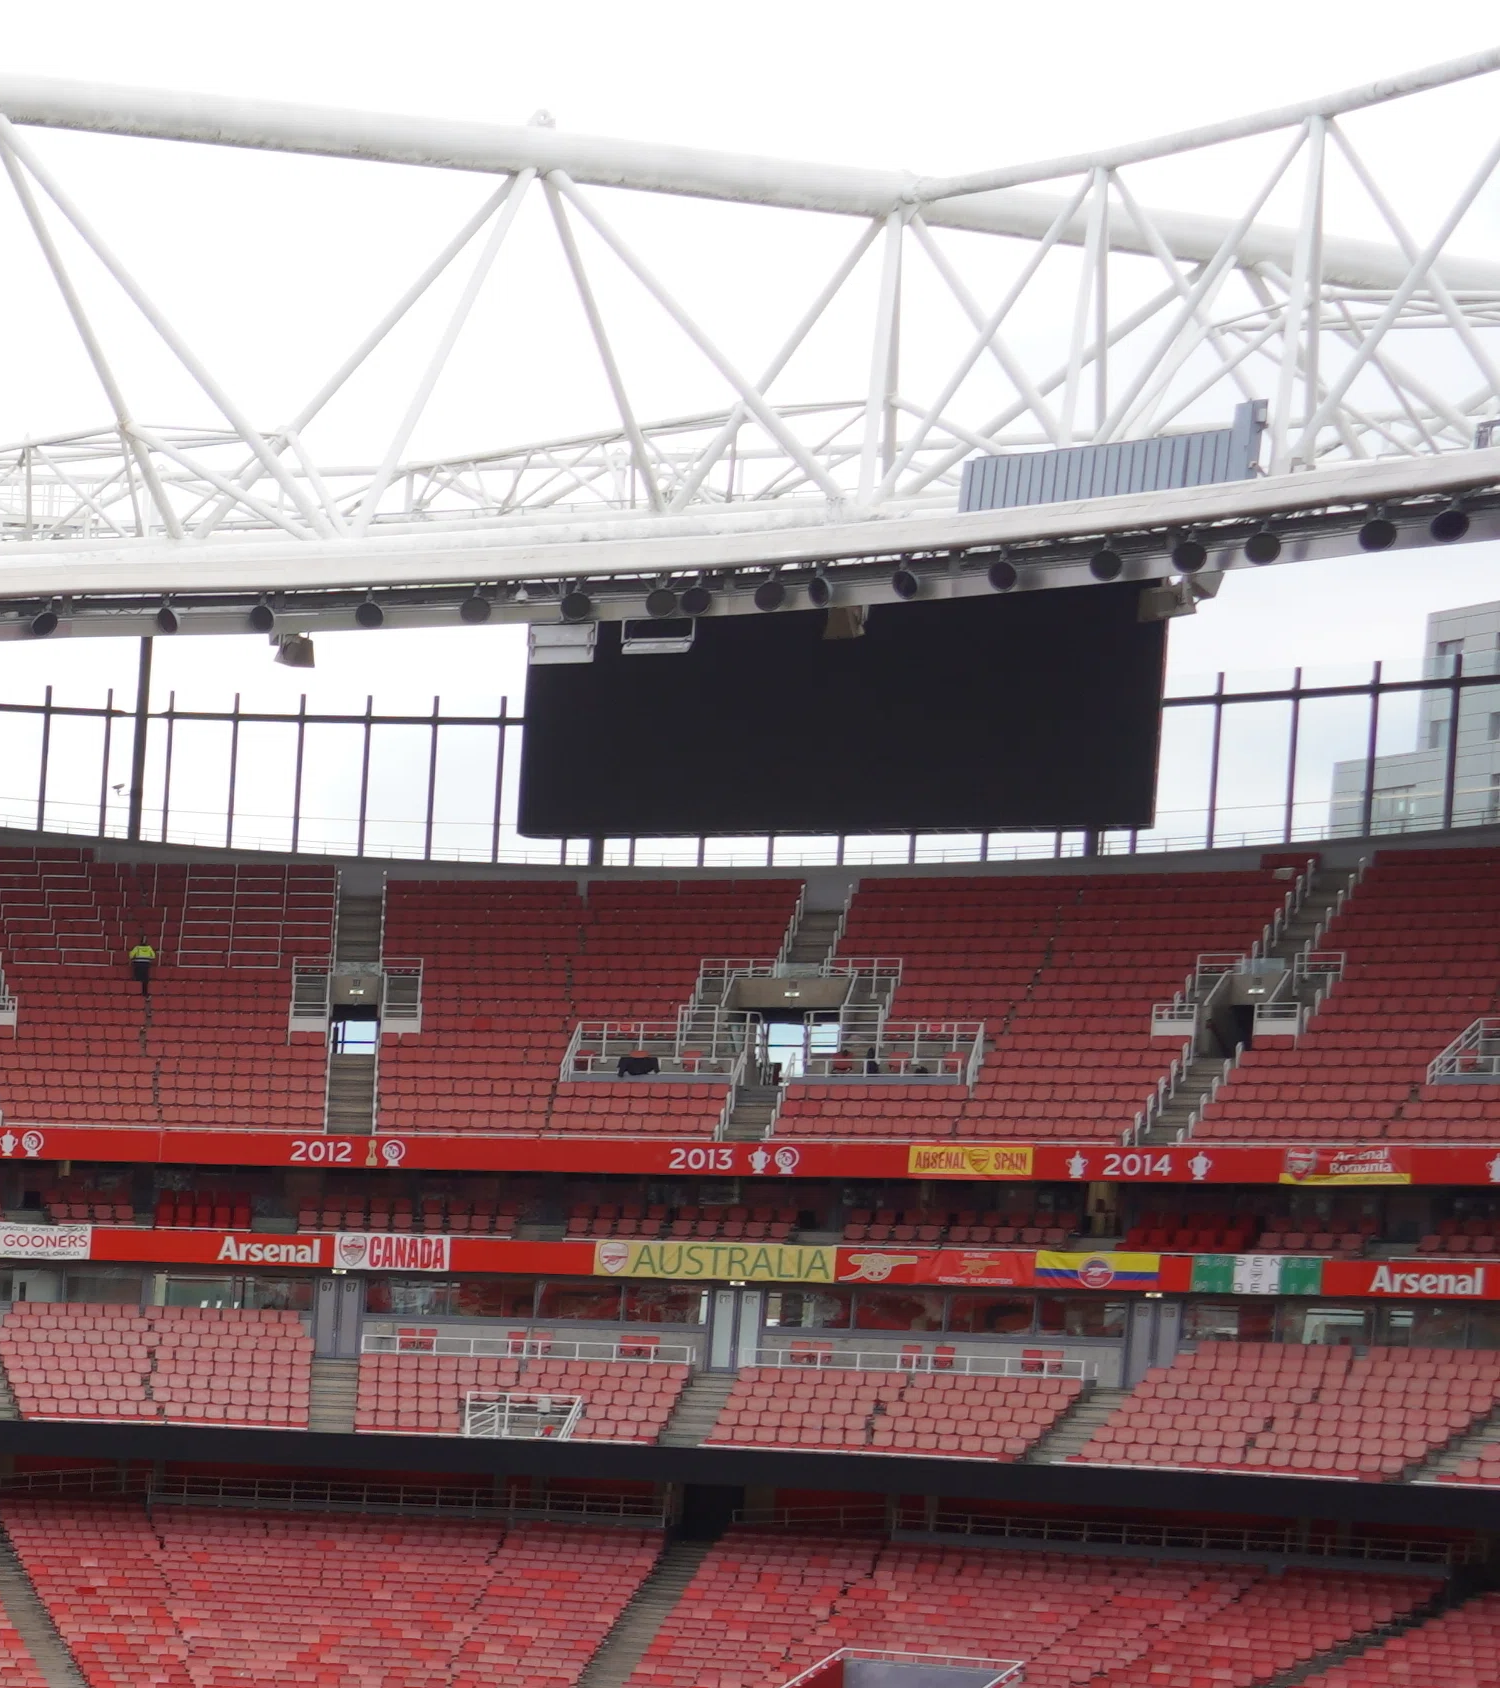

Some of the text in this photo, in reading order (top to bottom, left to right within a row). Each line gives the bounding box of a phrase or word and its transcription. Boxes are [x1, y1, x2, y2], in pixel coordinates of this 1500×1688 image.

[289, 1140, 352, 1163] 2012
[668, 1147, 734, 1171] 2013
[913, 1150, 1027, 1173] ARSENAL SPAIN
[1102, 1152, 1173, 1177] 2014
[1329, 1160, 1393, 1174] Romania
[3, 1234, 88, 1248] GOONERS
[217, 1236, 320, 1264] Arsenal
[368, 1236, 446, 1270] CANADA
[631, 1243, 830, 1280] AUSTRALIA
[321, 1282, 333, 1292] 67
[345, 1283, 357, 1293] 67
[1368, 1264, 1486, 1296] Arsenal
